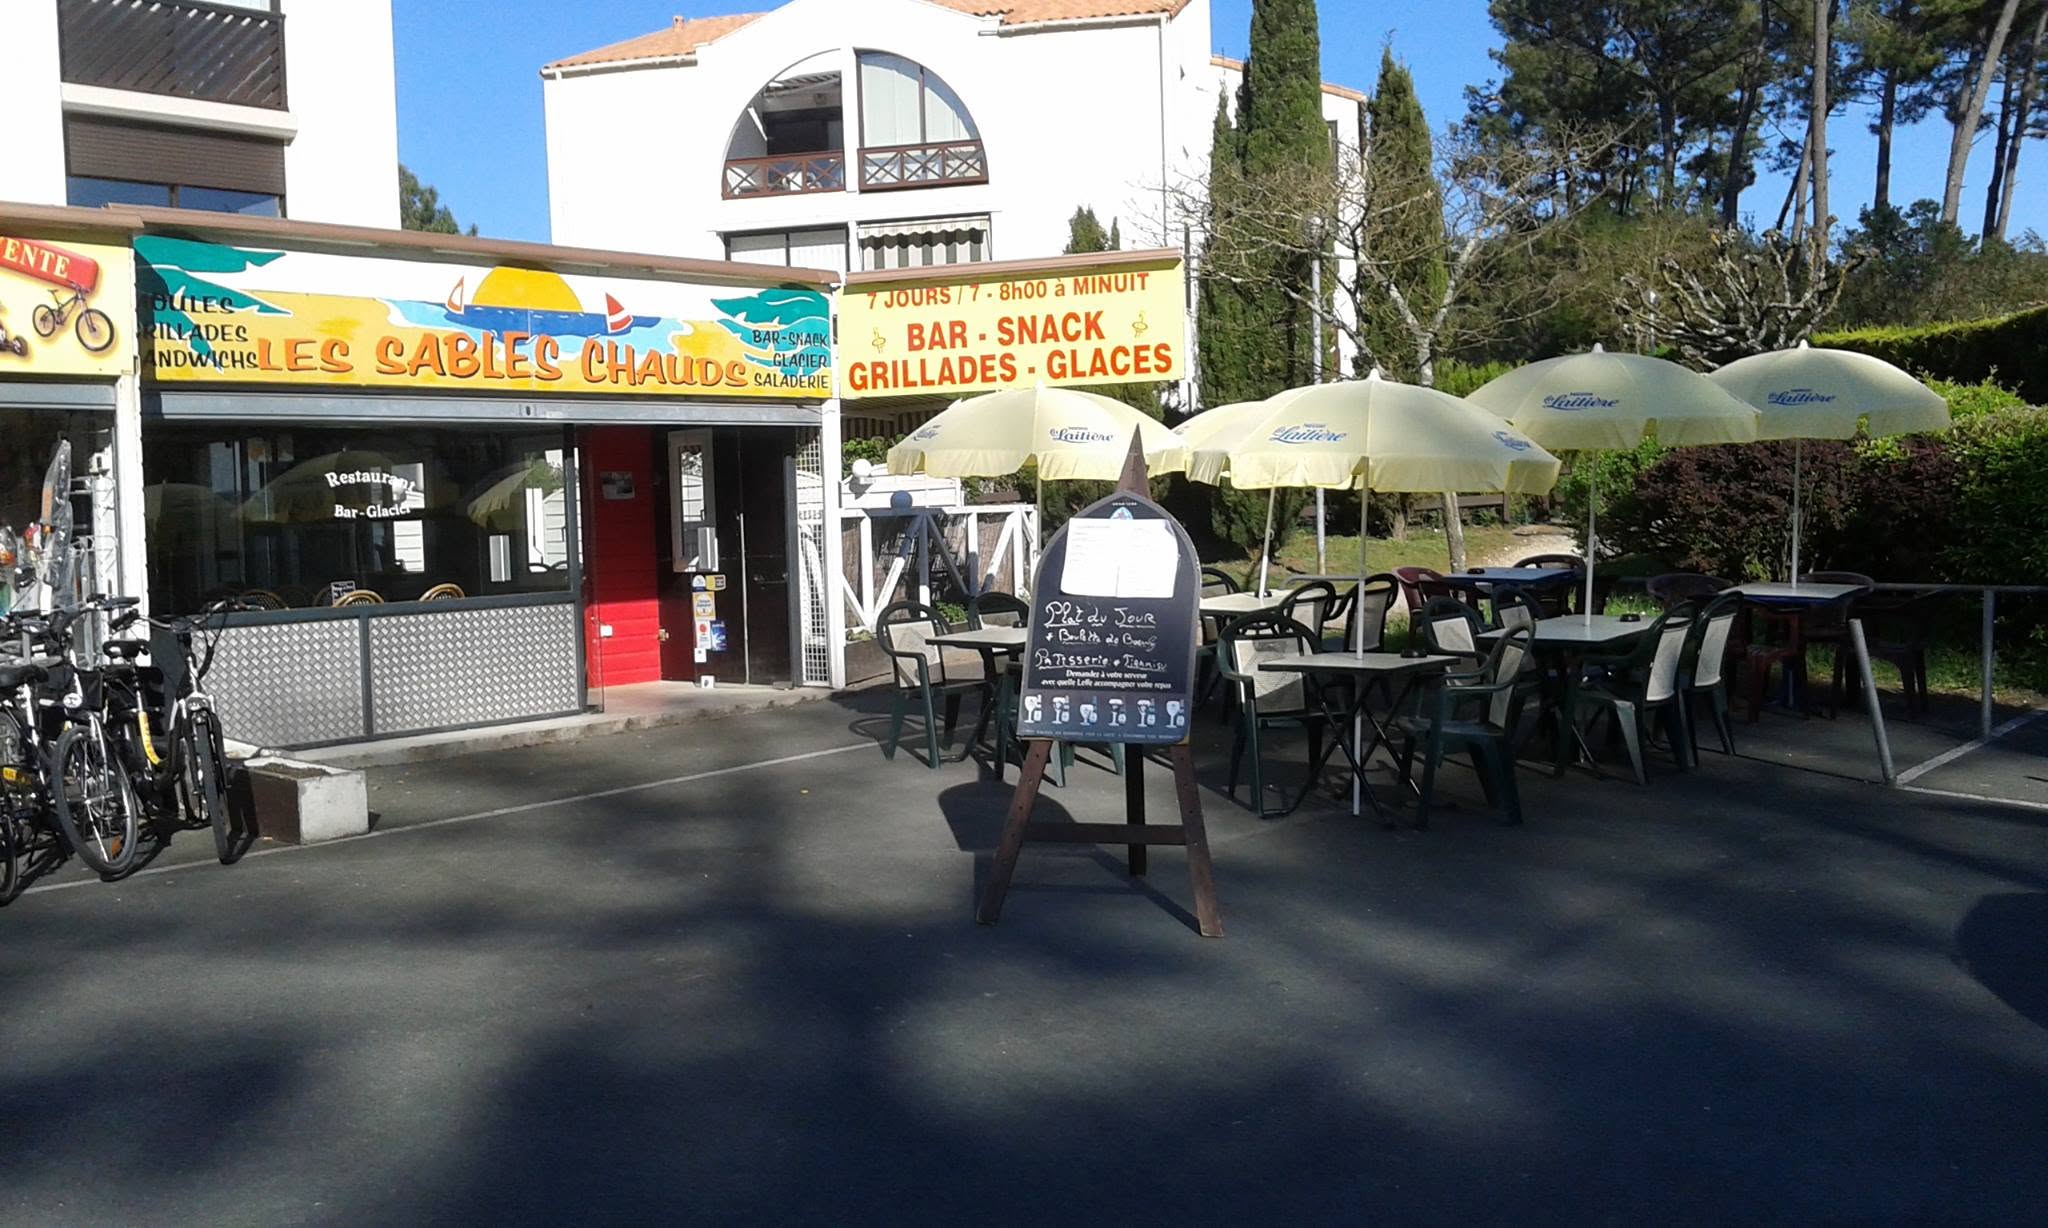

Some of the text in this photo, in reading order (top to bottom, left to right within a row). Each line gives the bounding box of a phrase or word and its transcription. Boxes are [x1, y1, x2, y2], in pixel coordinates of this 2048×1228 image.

[0, 236, 71, 279] ENTE
[867, 291, 877, 309] 7
[884, 287, 951, 308] JOURS
[970, 284, 980, 301] 7
[999, 281, 1046, 301] 8h00
[1054, 279, 1065, 297] à
[1073, 272, 1150, 296] MINUIT
[143, 293, 236, 314] OULES
[753, 329, 828, 347] BAR-SNACK
[907, 320, 968, 351] BAR
[997, 310, 1106, 346] SNACK
[145, 349, 259, 369] ANDWICHS
[258, 330, 749, 387] LES SABLES CHAUDS
[773, 352, 828, 368] GLACIER
[850, 353, 1017, 391] GRILLADES
[1047, 343, 1173, 379] GLACES
[754, 373, 829, 389] SALADERIE
[324, 470, 417, 492] Restaurant
